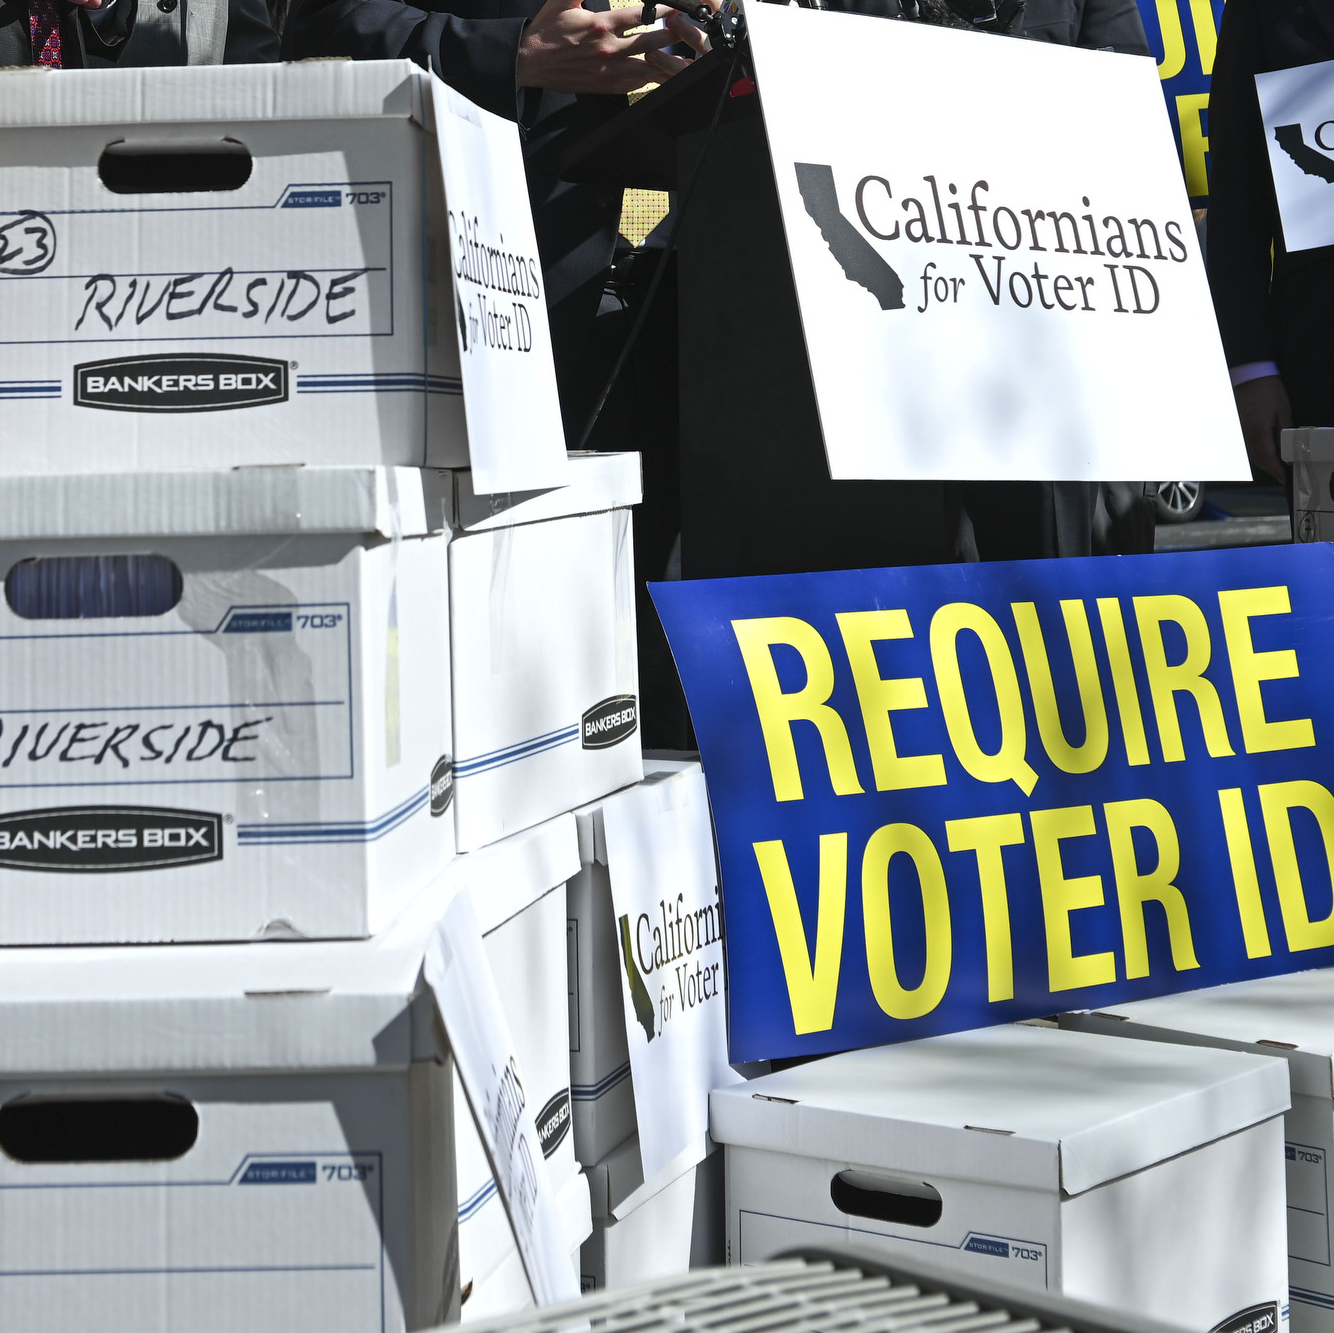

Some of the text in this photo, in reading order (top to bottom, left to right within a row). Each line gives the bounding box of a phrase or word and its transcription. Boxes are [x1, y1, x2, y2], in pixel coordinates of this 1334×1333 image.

[854, 175, 1188, 263] Californians
[449, 210, 540, 300] Californians
[917, 253, 1160, 315] for Voter ID
[74, 266, 373, 332] RIVERSIDE
[477, 293, 513, 351] Voter
[512, 302, 532, 353] ID
[86, 371, 278, 395] BANKERS BOX
[585, 706, 636, 737] BANKERS BOX
[729, 584, 1317, 803] REQUIRE
[143, 826, 210, 848] BOX
[636, 884, 723, 975] Californi
[751, 797, 1202, 1037] VOTER
[658, 960, 719, 1038] for Voter
[539, 1111, 560, 1147] ANKERS
[1253, 1311, 1275, 1333] BOX
